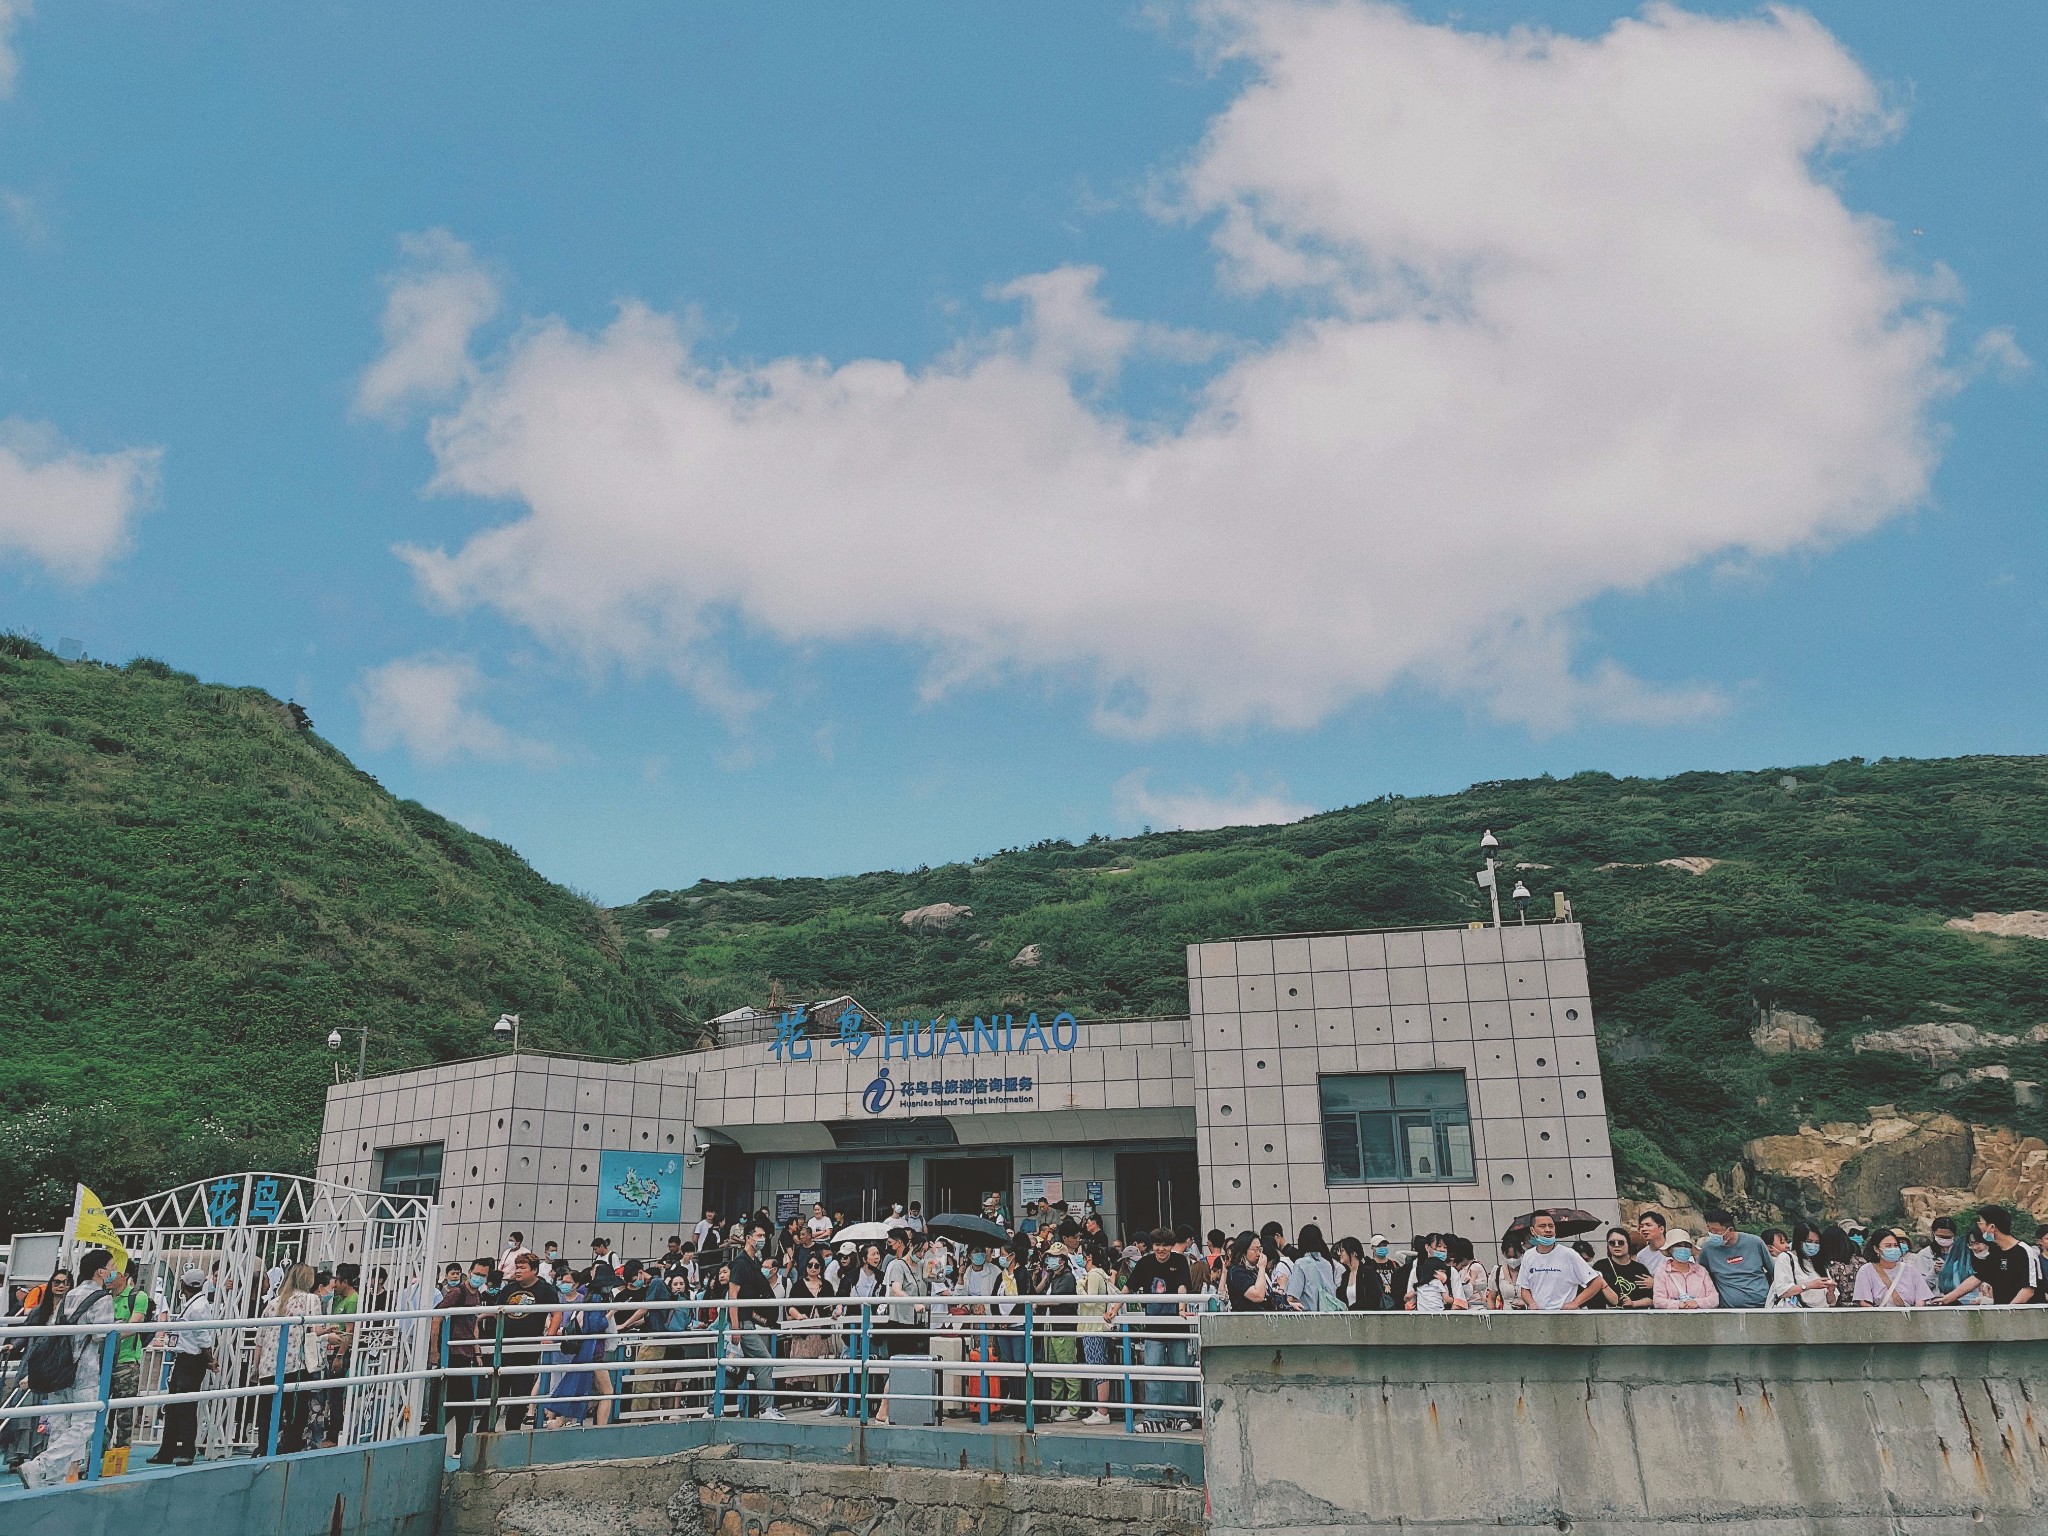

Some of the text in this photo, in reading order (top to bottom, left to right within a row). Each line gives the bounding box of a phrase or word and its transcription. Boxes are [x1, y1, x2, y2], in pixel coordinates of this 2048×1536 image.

[767, 1003, 1077, 1061] 花鸟 HUANIAO
[900, 1076, 1033, 1097] 花鸟岛旅游咨询服务
[900, 1095, 1034, 1108] Huaniao Island Tourist Information
[207, 1175, 280, 1228] 花鸟
